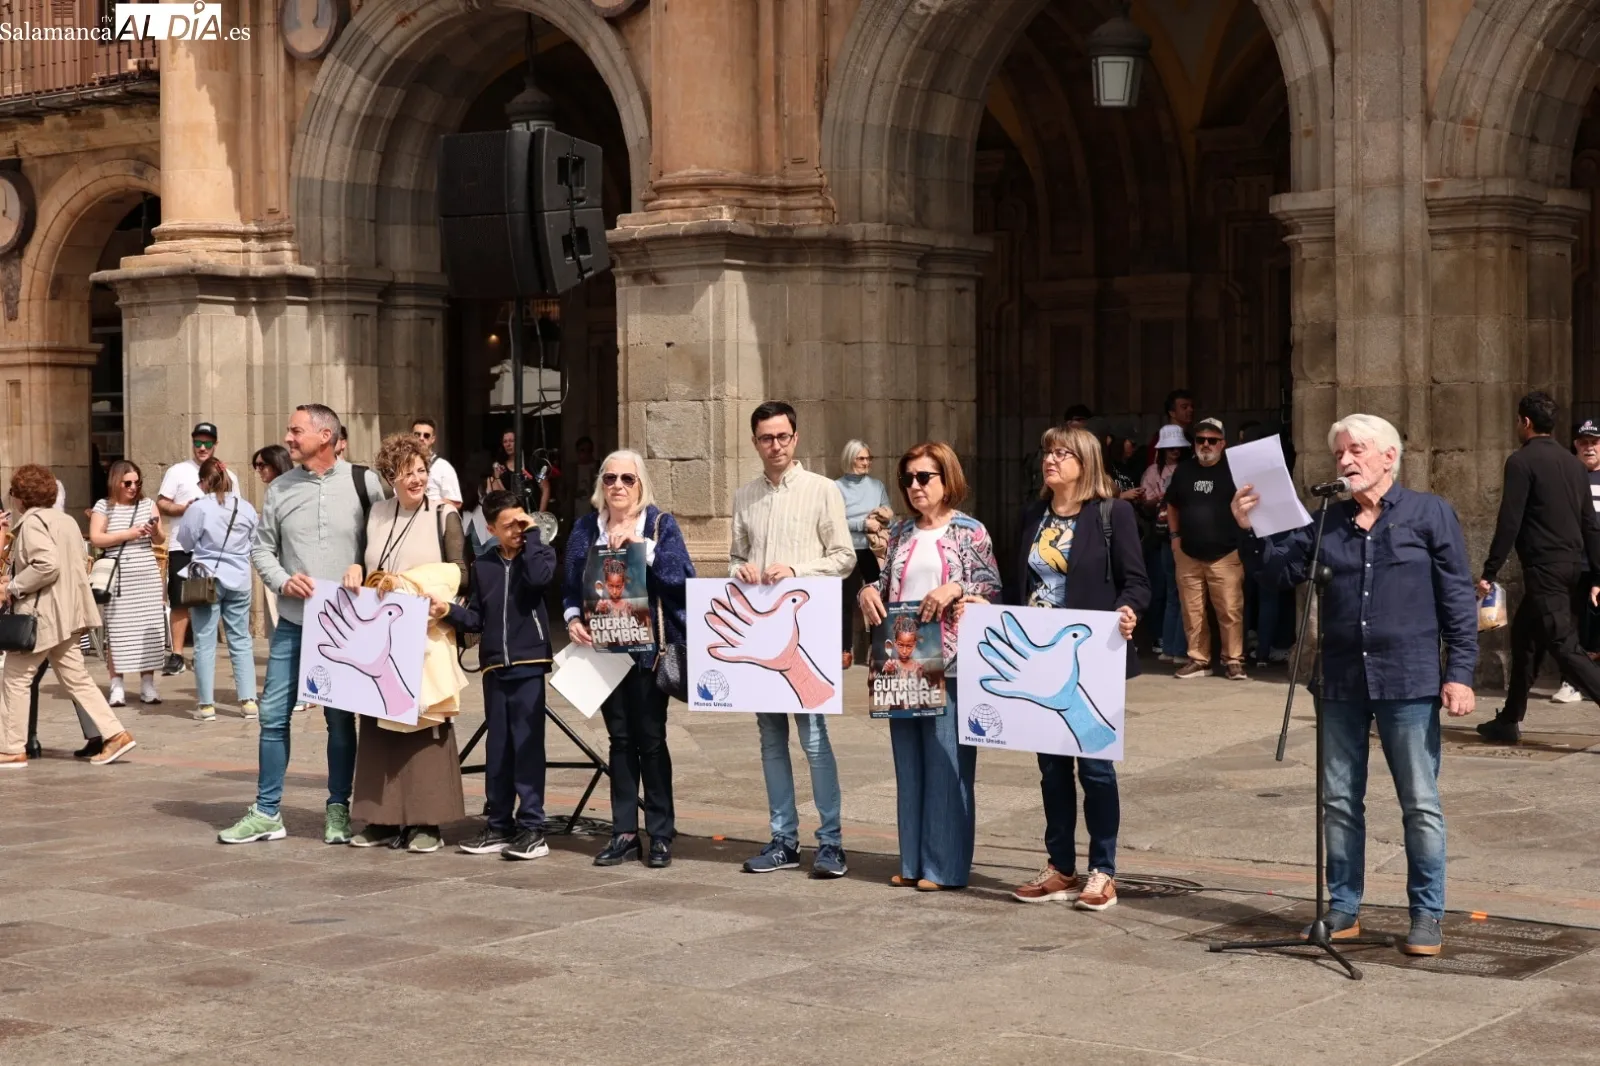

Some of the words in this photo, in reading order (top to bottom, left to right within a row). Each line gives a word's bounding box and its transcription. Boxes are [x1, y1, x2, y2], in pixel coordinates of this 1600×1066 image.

[589, 616, 638, 631] GUERRA
[591, 627, 650, 644] HAMBRE
[873, 677, 930, 692] GUERRA
[873, 689, 942, 706] HAMBRE
[965, 735, 985, 743] Manos
[986, 738, 1007, 746] Unidas
